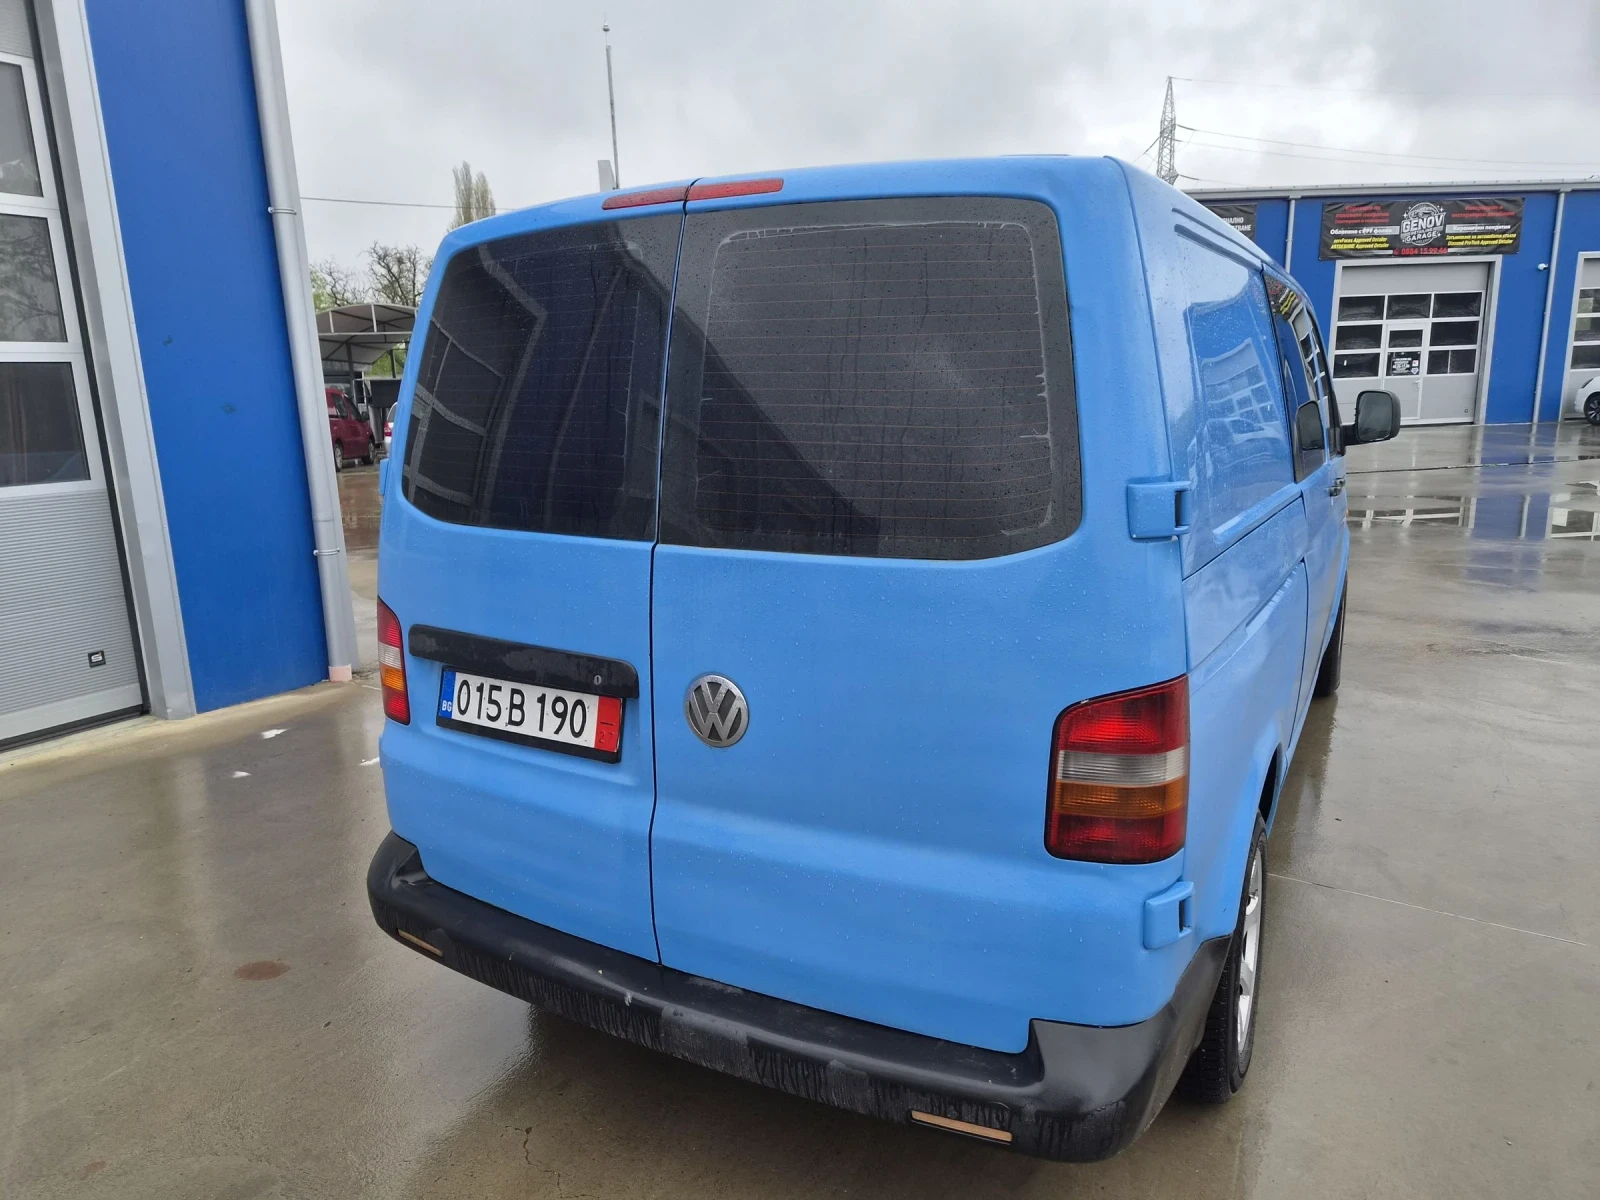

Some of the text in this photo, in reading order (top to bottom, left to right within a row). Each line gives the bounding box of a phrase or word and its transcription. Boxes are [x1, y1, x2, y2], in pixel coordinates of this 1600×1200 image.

[1402, 214, 1443, 233] GENOV
[1406, 230, 1438, 242] GARAGE
[1401, 247, 1418, 255] 0884
[441, 700, 453, 712] BG
